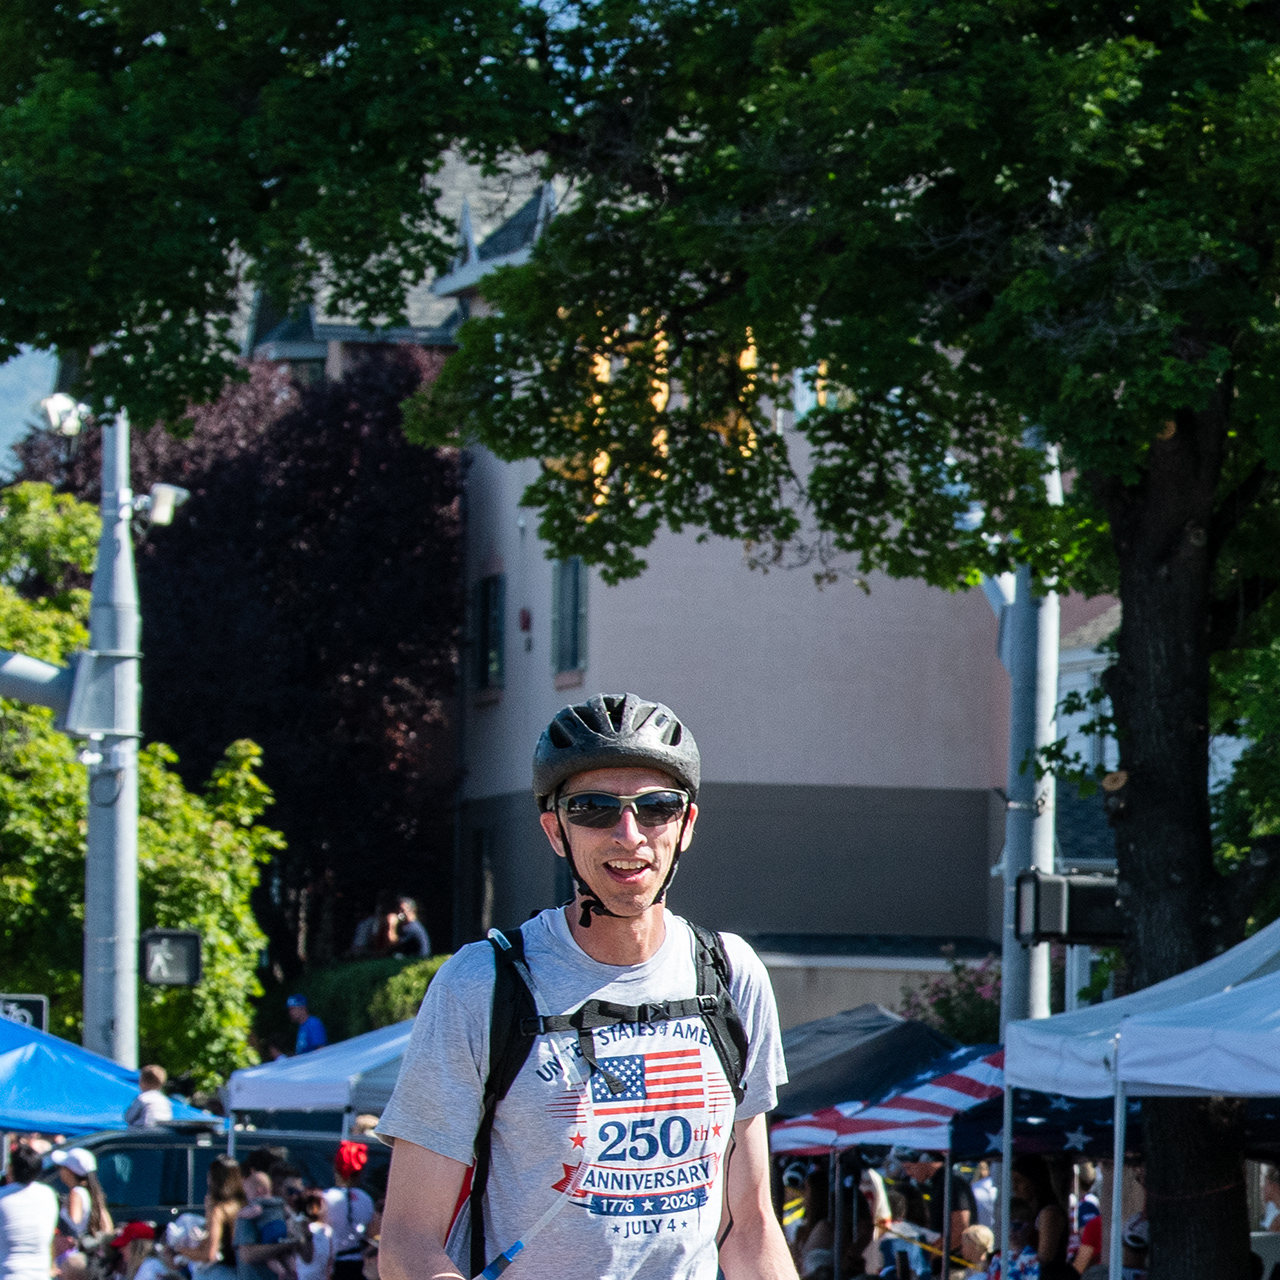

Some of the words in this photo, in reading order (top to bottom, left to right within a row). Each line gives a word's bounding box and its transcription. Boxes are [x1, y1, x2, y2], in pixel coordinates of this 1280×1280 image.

[659, 1024, 667, 1036] of
[598, 1116, 692, 1162] 250
[694, 1125, 708, 1141] th
[583, 1161, 710, 1190] ANNIVERSARY
[601, 1199, 635, 1212] 1776
[660, 1193, 697, 1211] 2026
[624, 1218, 662, 1238] JULY
[667, 1219, 676, 1231] 4
